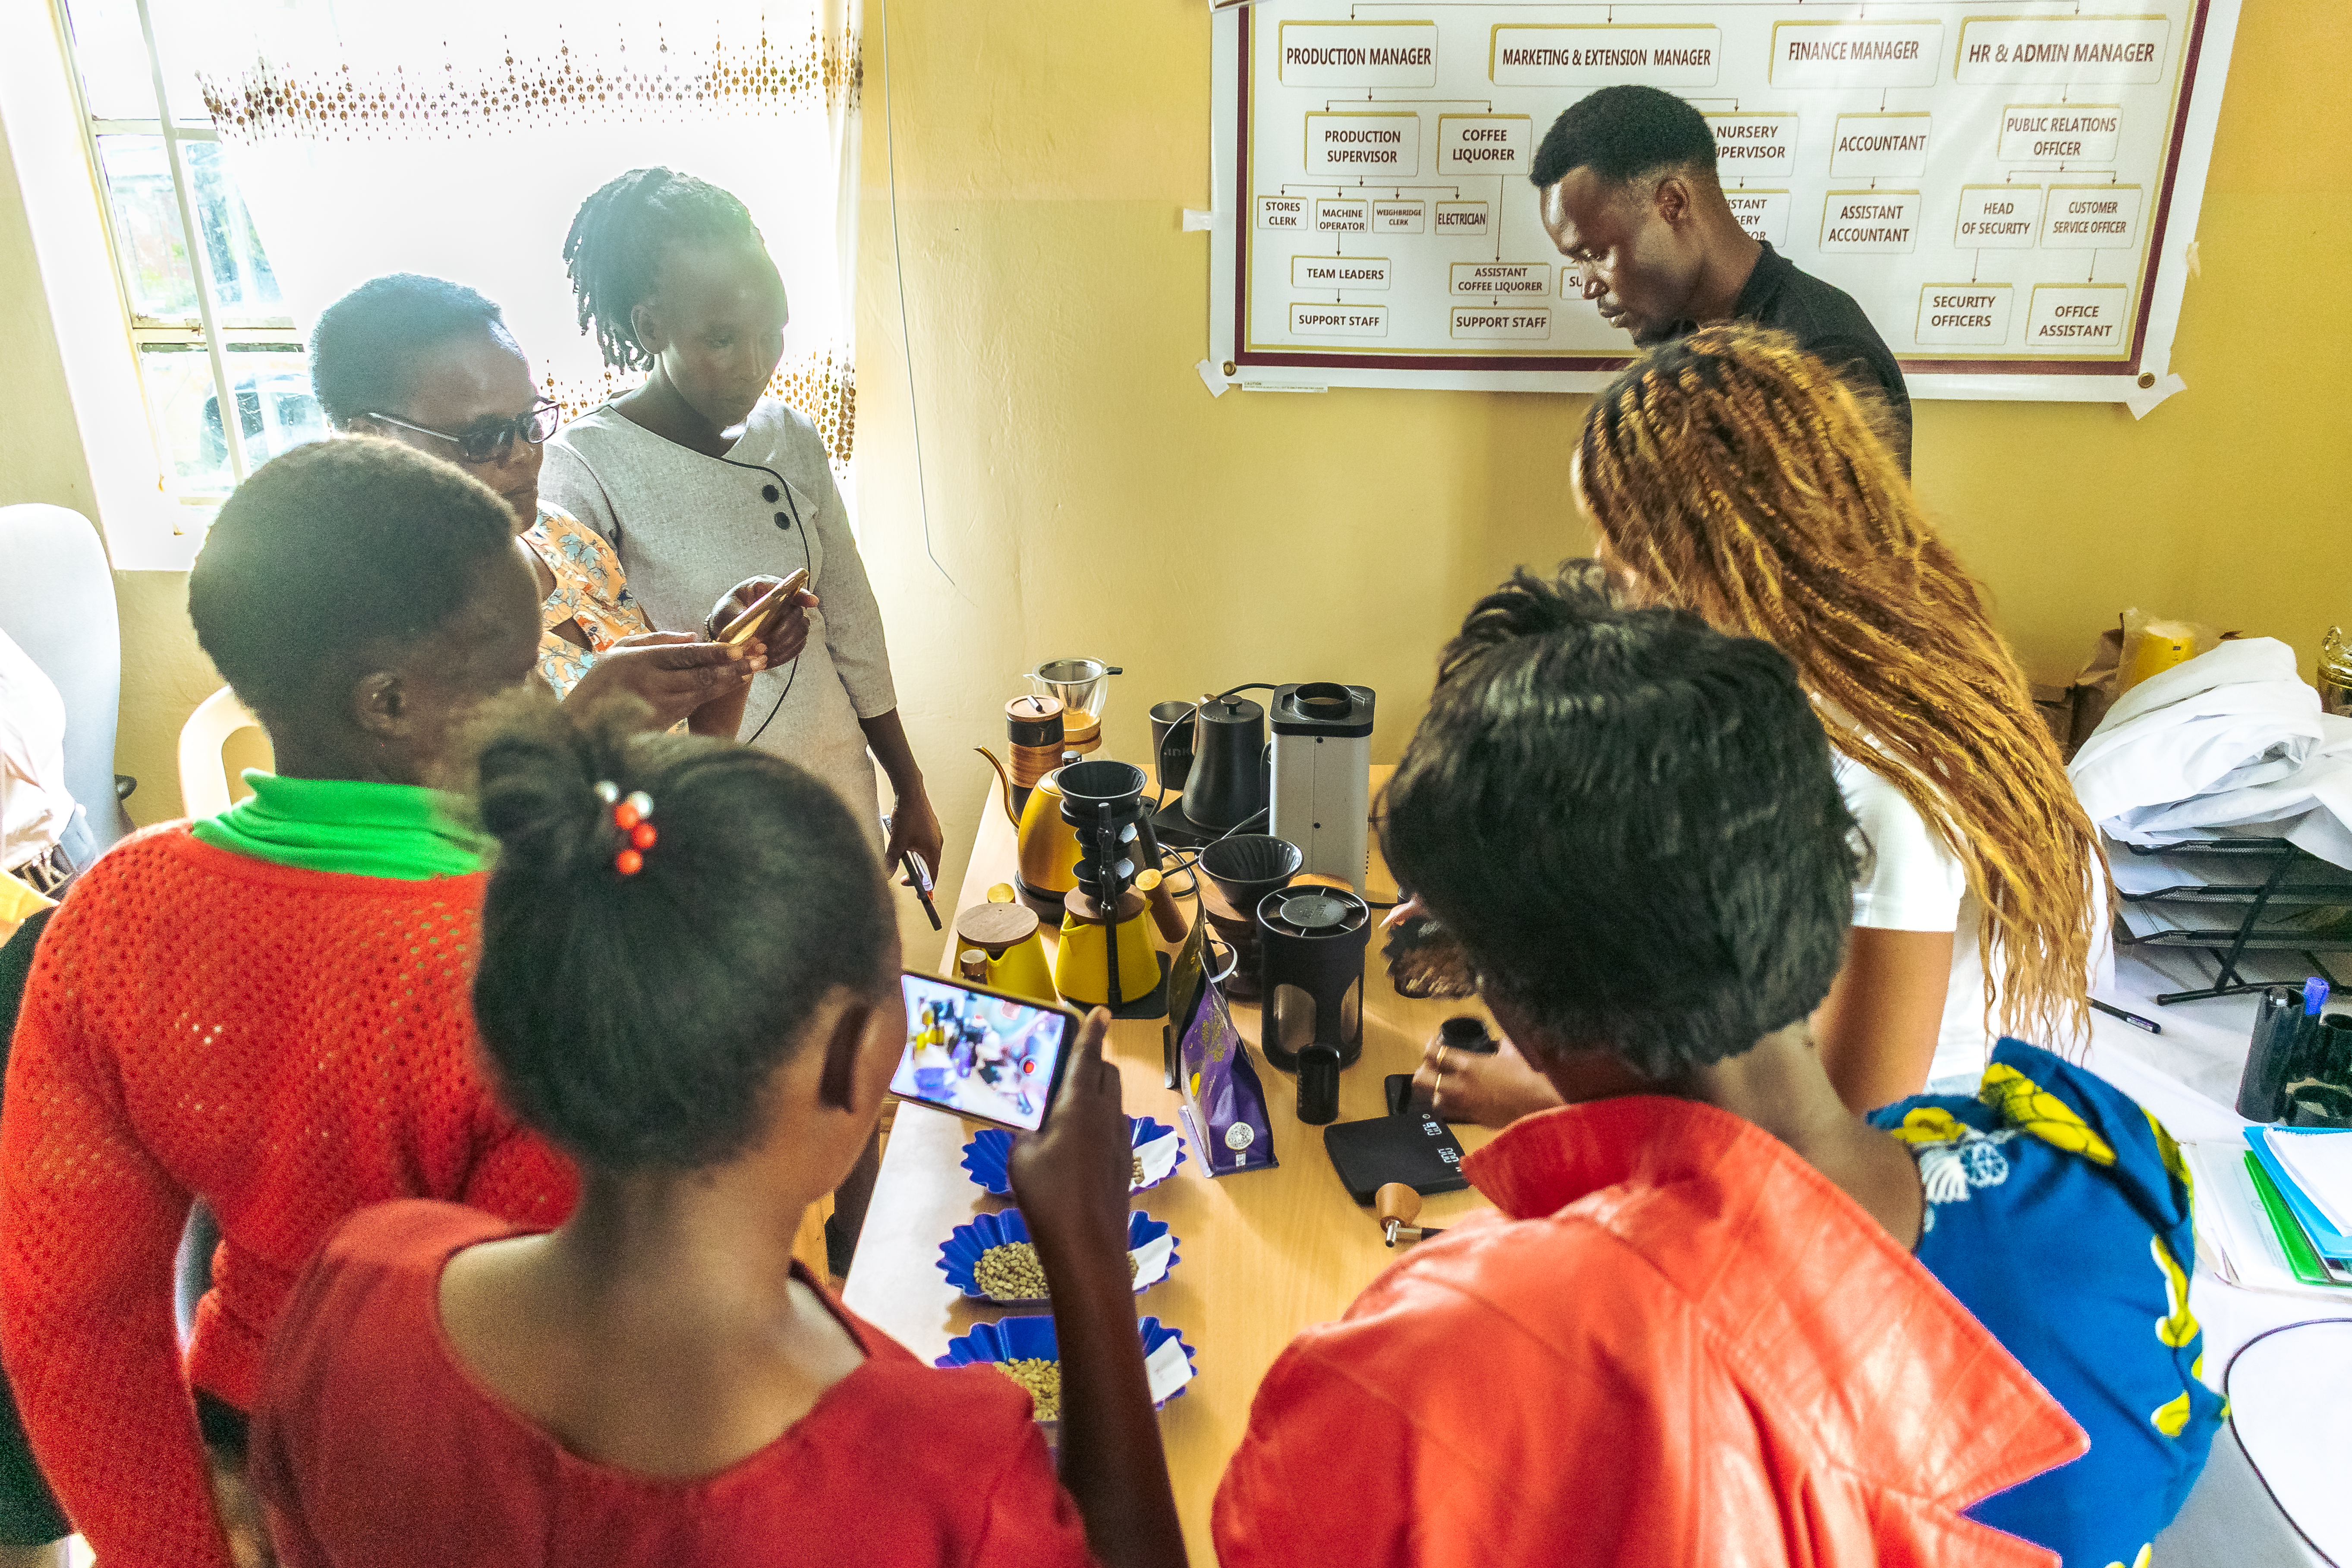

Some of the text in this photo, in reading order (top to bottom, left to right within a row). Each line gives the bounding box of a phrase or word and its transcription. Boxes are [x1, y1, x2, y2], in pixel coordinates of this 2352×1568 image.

[1287, 48, 1431, 65] PRODUCTION MANAGER
[1788, 41, 1919, 60] FINANCE MANAGER
[1969, 43, 2155, 63] HR & ADMIN MANAGER
[1503, 49, 1710, 66] MARKETING & EXTENSION MANAGER
[2006, 117, 2117, 132] PUBLIC RELATIONS
[1325, 130, 1401, 143] PRODUCTION
[1462, 129, 1507, 141] COFFEE
[1716, 126, 1778, 138] NURSERY
[1839, 135, 1926, 151] ACCOUNTANT
[2034, 141, 2081, 156] OFFICER
[1327, 150, 1397, 163] SUPERVISOR
[1453, 148, 1514, 164] LIQUORER
[1717, 146, 1785, 158] PERVISOR
[1266, 202, 1300, 212] STORES
[1727, 199, 1767, 209] STANT
[1984, 202, 2014, 214] HEAD
[2069, 202, 2118, 214] CUSTOMER
[1322, 209, 1363, 218] MACHINE
[1840, 205, 1904, 219] ASSISTANT
[1269, 216, 1297, 226] CLERK
[1438, 213, 1486, 225] ELECTRICIAN
[1319, 221, 1365, 230] OPERATOR
[1962, 222, 2031, 234] OF SECURITY
[2053, 221, 2126, 233] SERVICE OFFICER
[1828, 228, 1910, 242] ACCOUNTANT
[1307, 268, 1384, 280] TEAM LEADERS
[1474, 268, 1528, 277] ASSISTANT
[1458, 281, 1542, 293] COFFEE LIQUORER
[1933, 296, 1996, 308] SECURITY
[2055, 305, 2100, 318] OFFICE
[1299, 315, 1379, 326] SUPPORT STAFF
[1456, 316, 1546, 328] SUPPORT STAFF
[1931, 315, 1991, 327] OFFICERS
[2039, 325, 2113, 337] ASSISTANT
